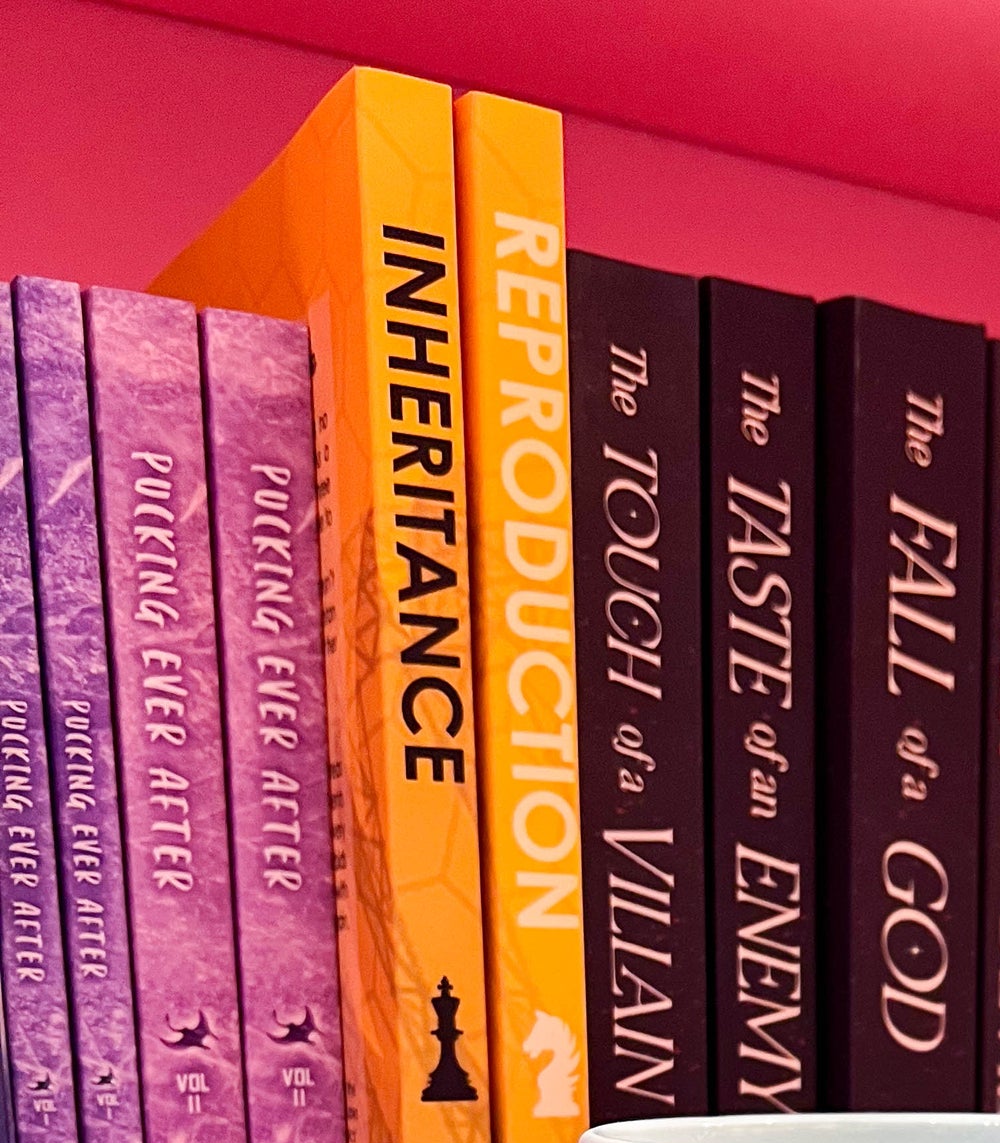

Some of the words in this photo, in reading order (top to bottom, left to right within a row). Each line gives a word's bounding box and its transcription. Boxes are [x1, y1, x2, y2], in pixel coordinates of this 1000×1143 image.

[610, 343, 649, 417] The
[741, 370, 781, 446] The
[904, 389, 945, 469] The
[131, 451, 181, 629] PUCKING
[250, 464, 295, 634] PUCKING
[382, 223, 466, 784] INHERITANCE
[494, 211, 581, 930] REPRODUCTION
[602, 442, 663, 701] TOUCH
[727, 473, 792, 711] TASTE
[887, 491, 958, 696] FALL
[140, 649, 188, 747] EVER
[257, 655, 300, 752] EVER
[744, 720, 789, 773] of
[1, 700, 33, 813] PUCKING
[62, 700, 96, 812] PUCKING
[612, 723, 656, 772] of
[618, 767, 645, 793] a
[750, 767, 778, 819] an
[896, 727, 940, 779] of
[901, 774, 928, 801] a
[8, 826, 40, 888] EVER
[71, 824, 102, 885] EVER
[148, 767, 194, 893] AFTER
[261, 769, 302, 892] AFTER
[12, 901, 45, 982] AFTER
[77, 899, 108, 978] AFTER
[602, 828, 675, 1107] VILLAIN
[734, 841, 802, 1114] ENEMY
[880, 839, 949, 1053] GOD
[176, 1072, 210, 1094] VOL
[282, 1067, 315, 1089] VOL
